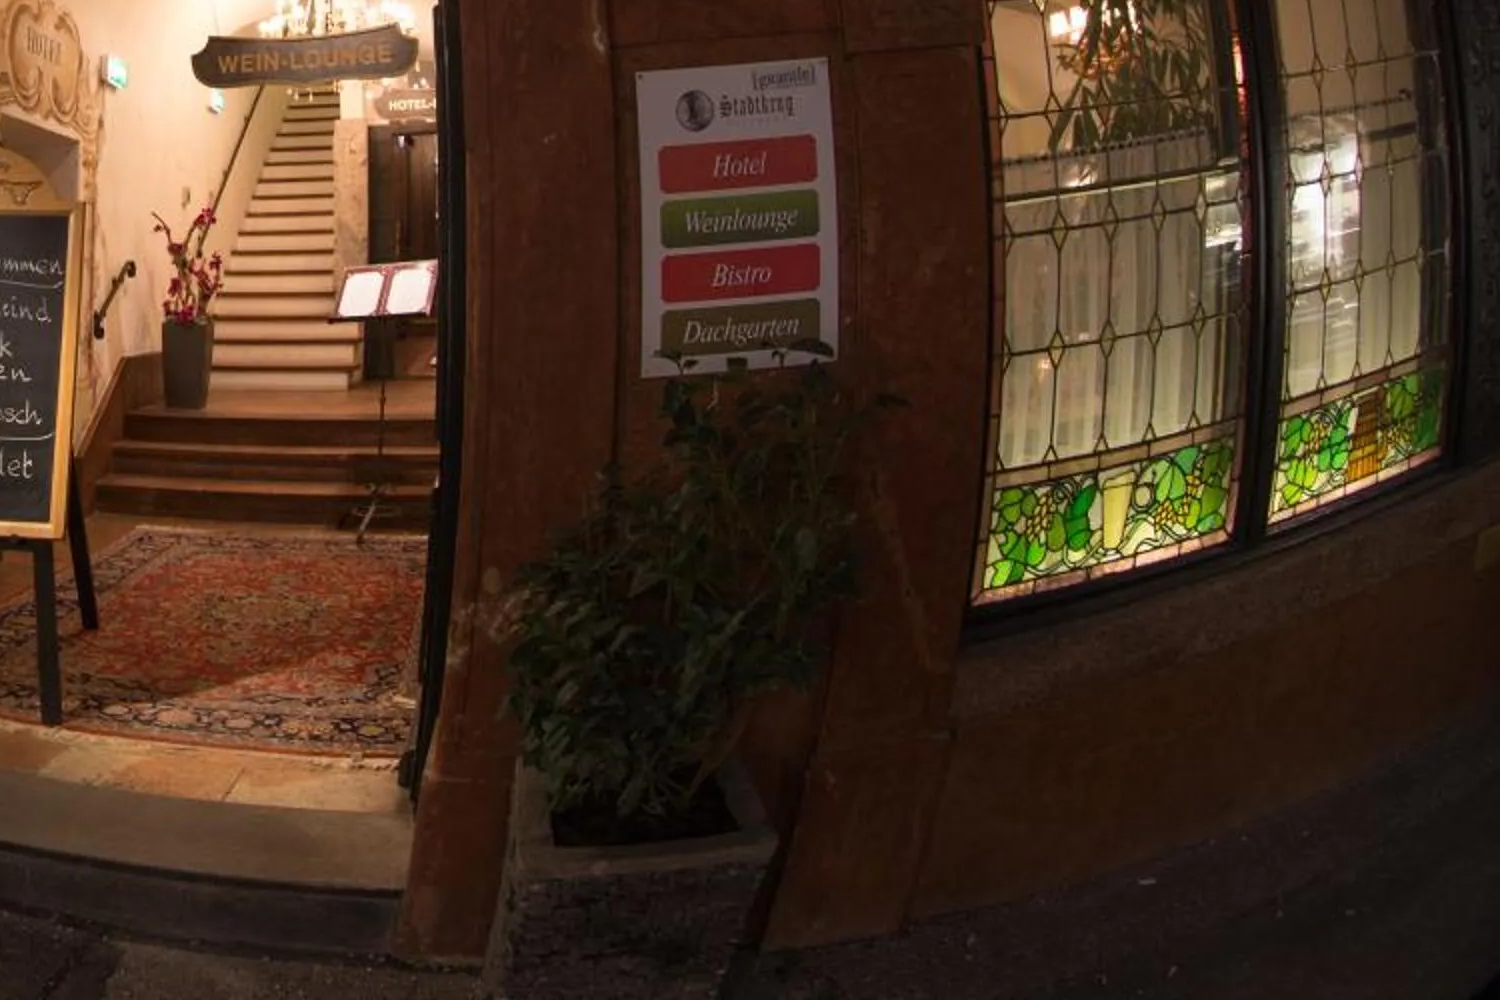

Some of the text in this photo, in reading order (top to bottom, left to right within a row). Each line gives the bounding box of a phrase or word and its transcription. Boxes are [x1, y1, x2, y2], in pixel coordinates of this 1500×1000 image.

[713, 152, 767, 177] Hotel
[685, 209, 799, 233] Weinlounge
[711, 263, 772, 287] Bistro
[683, 317, 800, 347] Dachgarten
